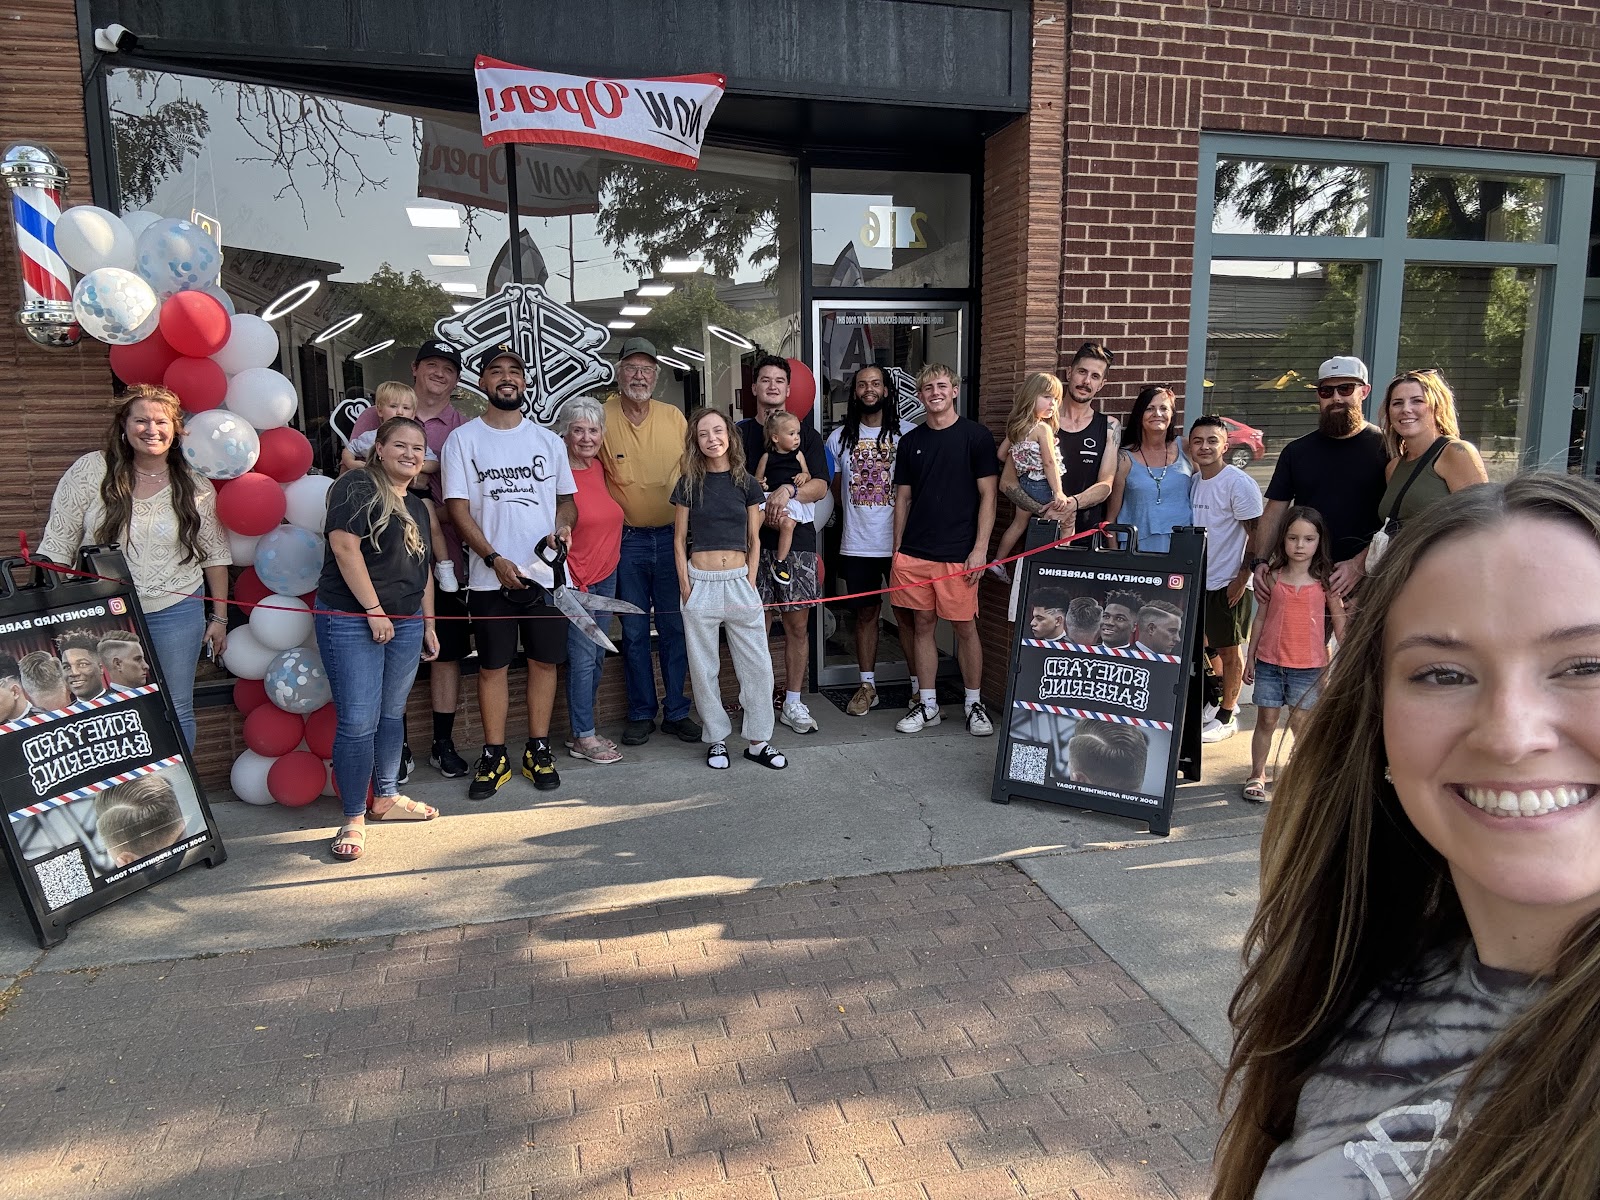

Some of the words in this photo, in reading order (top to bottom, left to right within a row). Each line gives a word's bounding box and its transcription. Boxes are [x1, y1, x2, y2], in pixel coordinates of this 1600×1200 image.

[836, 316, 845, 325] THIS
[846, 316, 857, 325] DOOR
[863, 316, 877, 325] REMAIN
[877, 316, 897, 325] UNLOCKED
[898, 316, 912, 325] DURING
[913, 316, 930, 325] BUSINESS
[931, 316, 944, 325] HOURS
